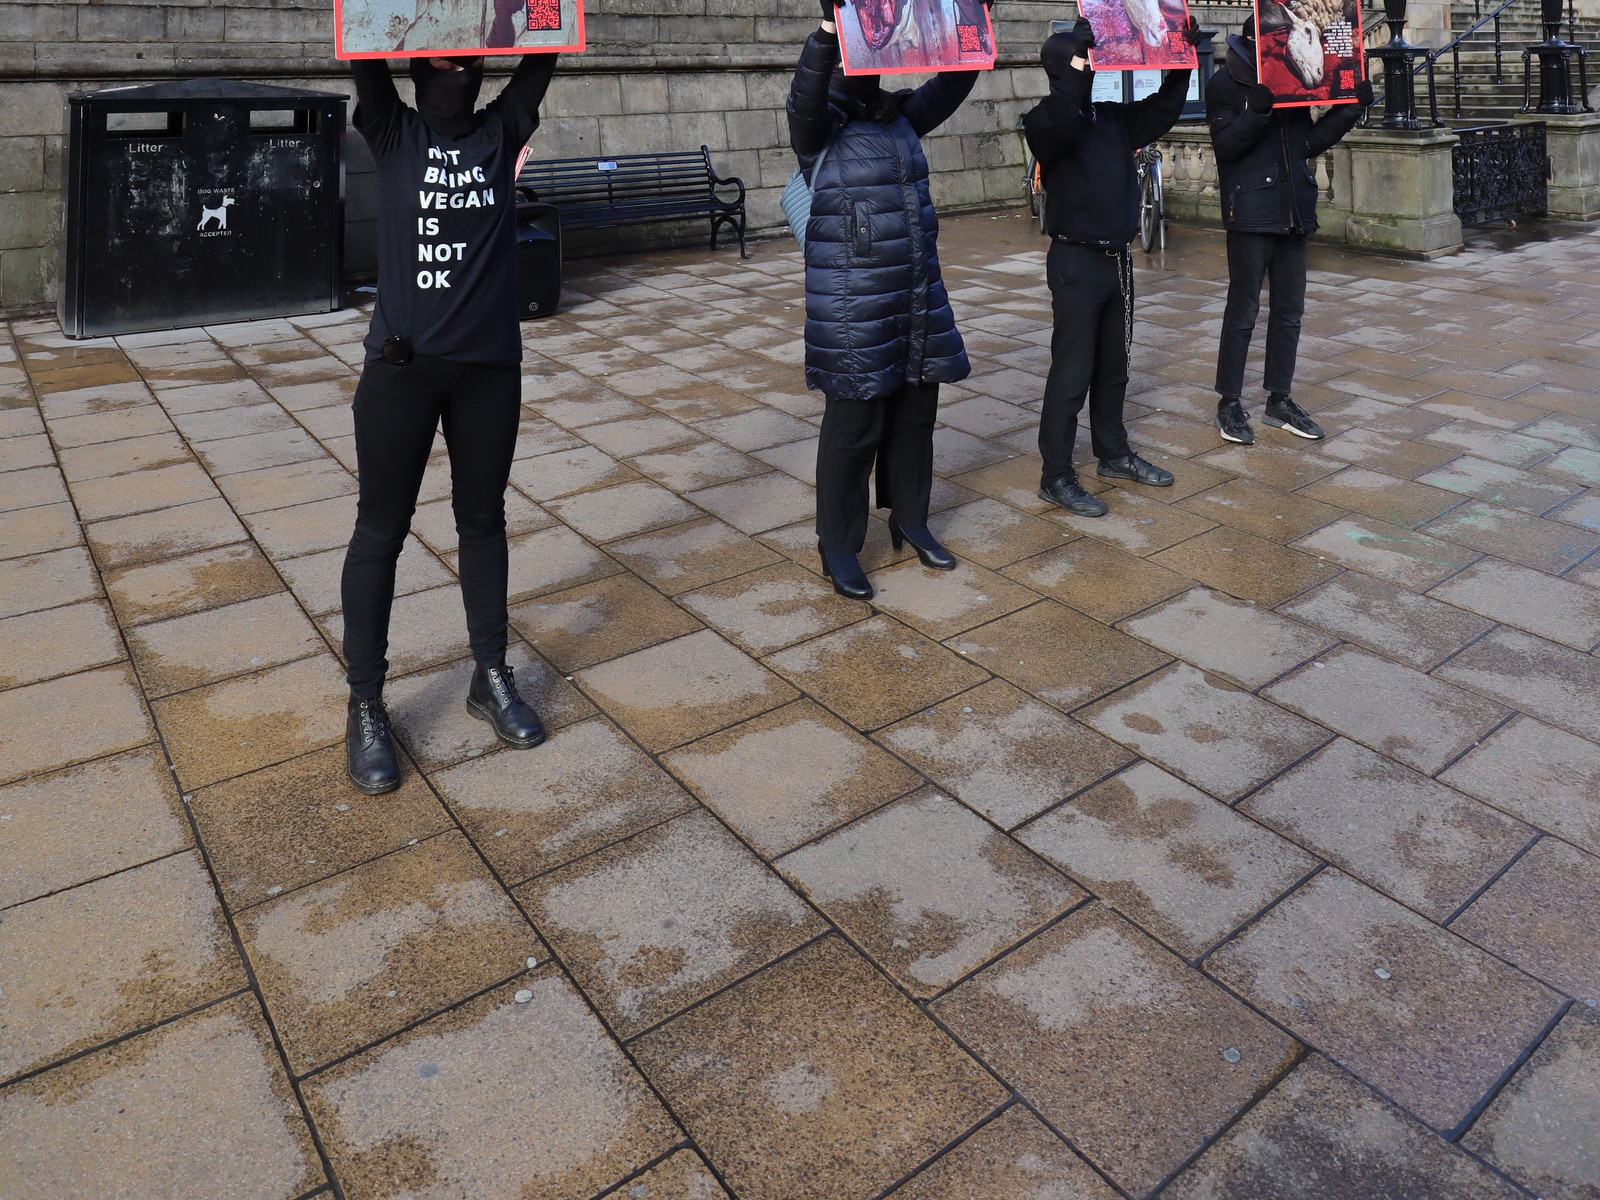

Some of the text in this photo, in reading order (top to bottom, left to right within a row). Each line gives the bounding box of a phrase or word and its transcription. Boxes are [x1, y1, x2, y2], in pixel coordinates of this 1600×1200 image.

[129, 143, 163, 153] Litter
[269, 139, 300, 149] Litter
[419, 188, 495, 210] VEGAN
[418, 218, 440, 236] IS
[418, 243, 467, 262] NOT
[417, 270, 451, 289] OK
